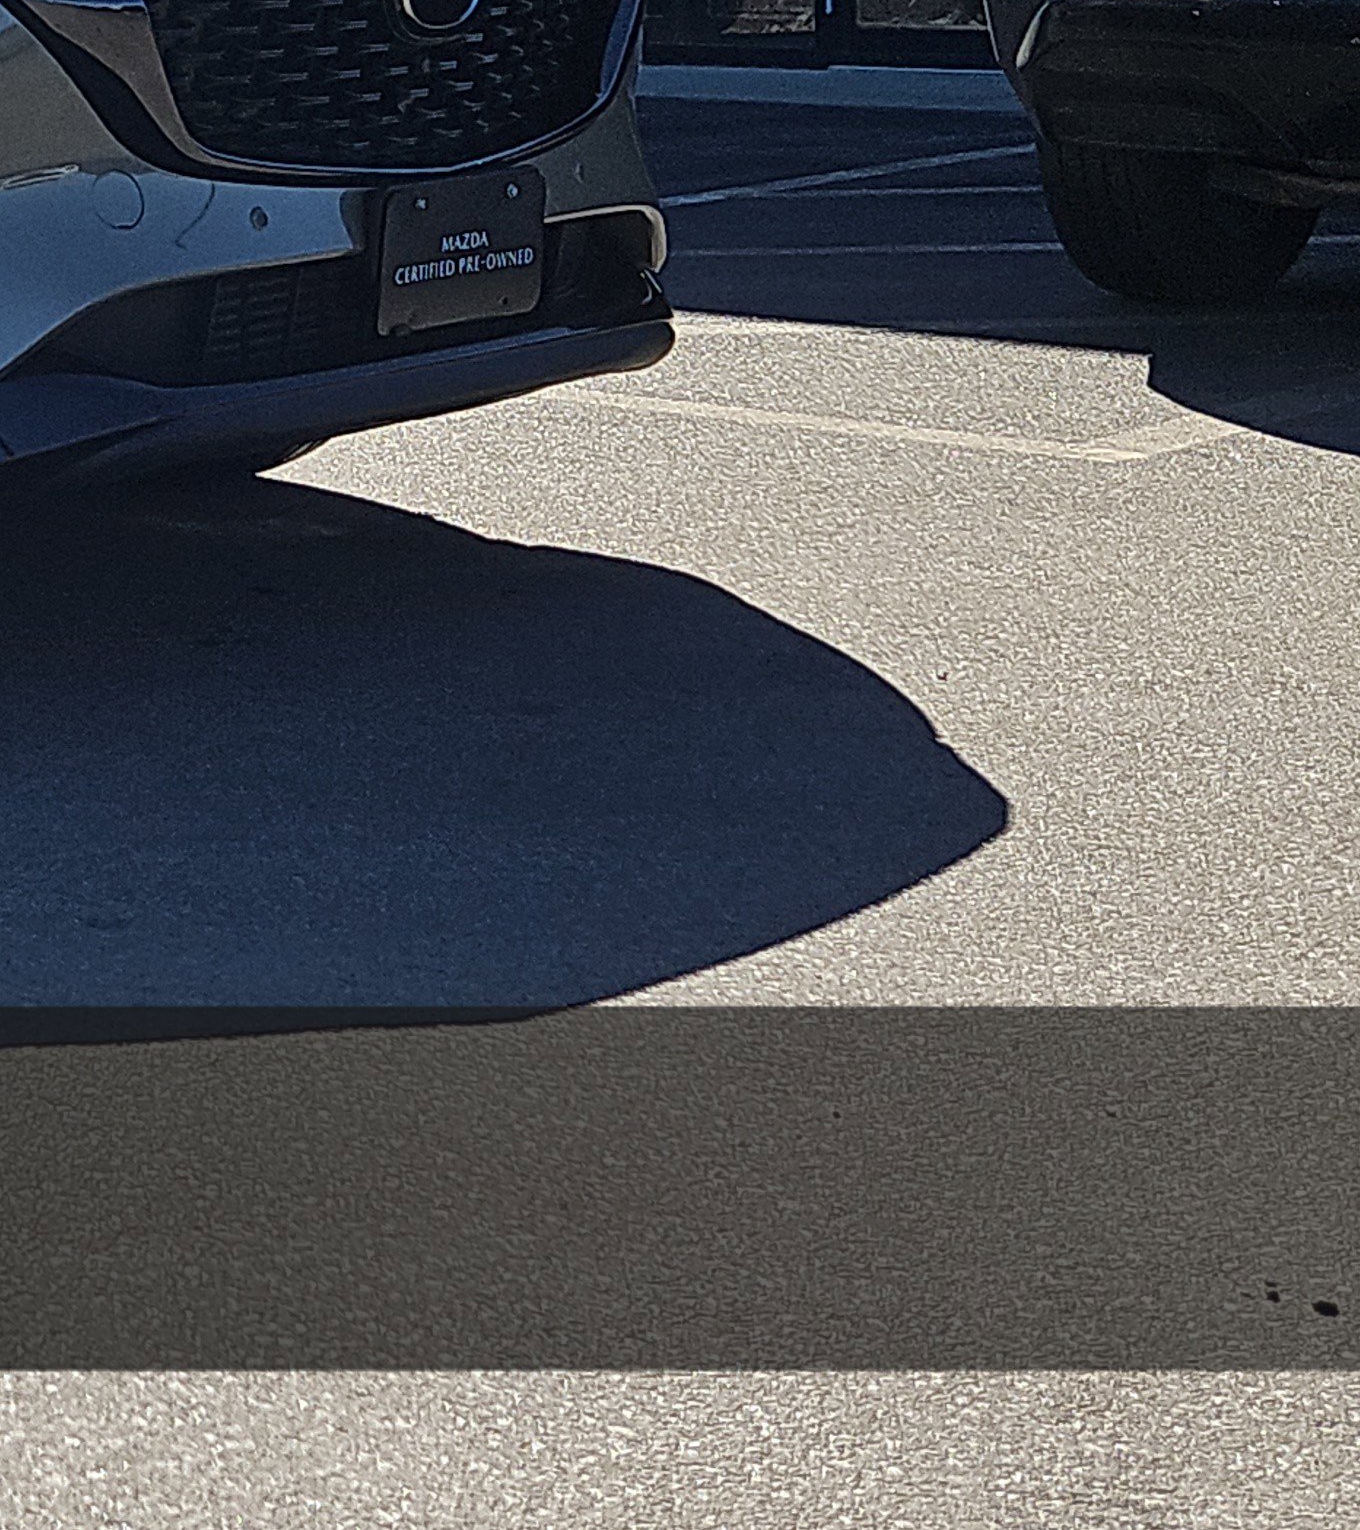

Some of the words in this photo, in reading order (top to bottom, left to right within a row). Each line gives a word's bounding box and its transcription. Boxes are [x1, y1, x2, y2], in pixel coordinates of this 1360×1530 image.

[441, 231, 489, 252] MAZDA
[394, 259, 456, 285] CERTIFIED
[458, 247, 534, 275] PRE-OWNED
